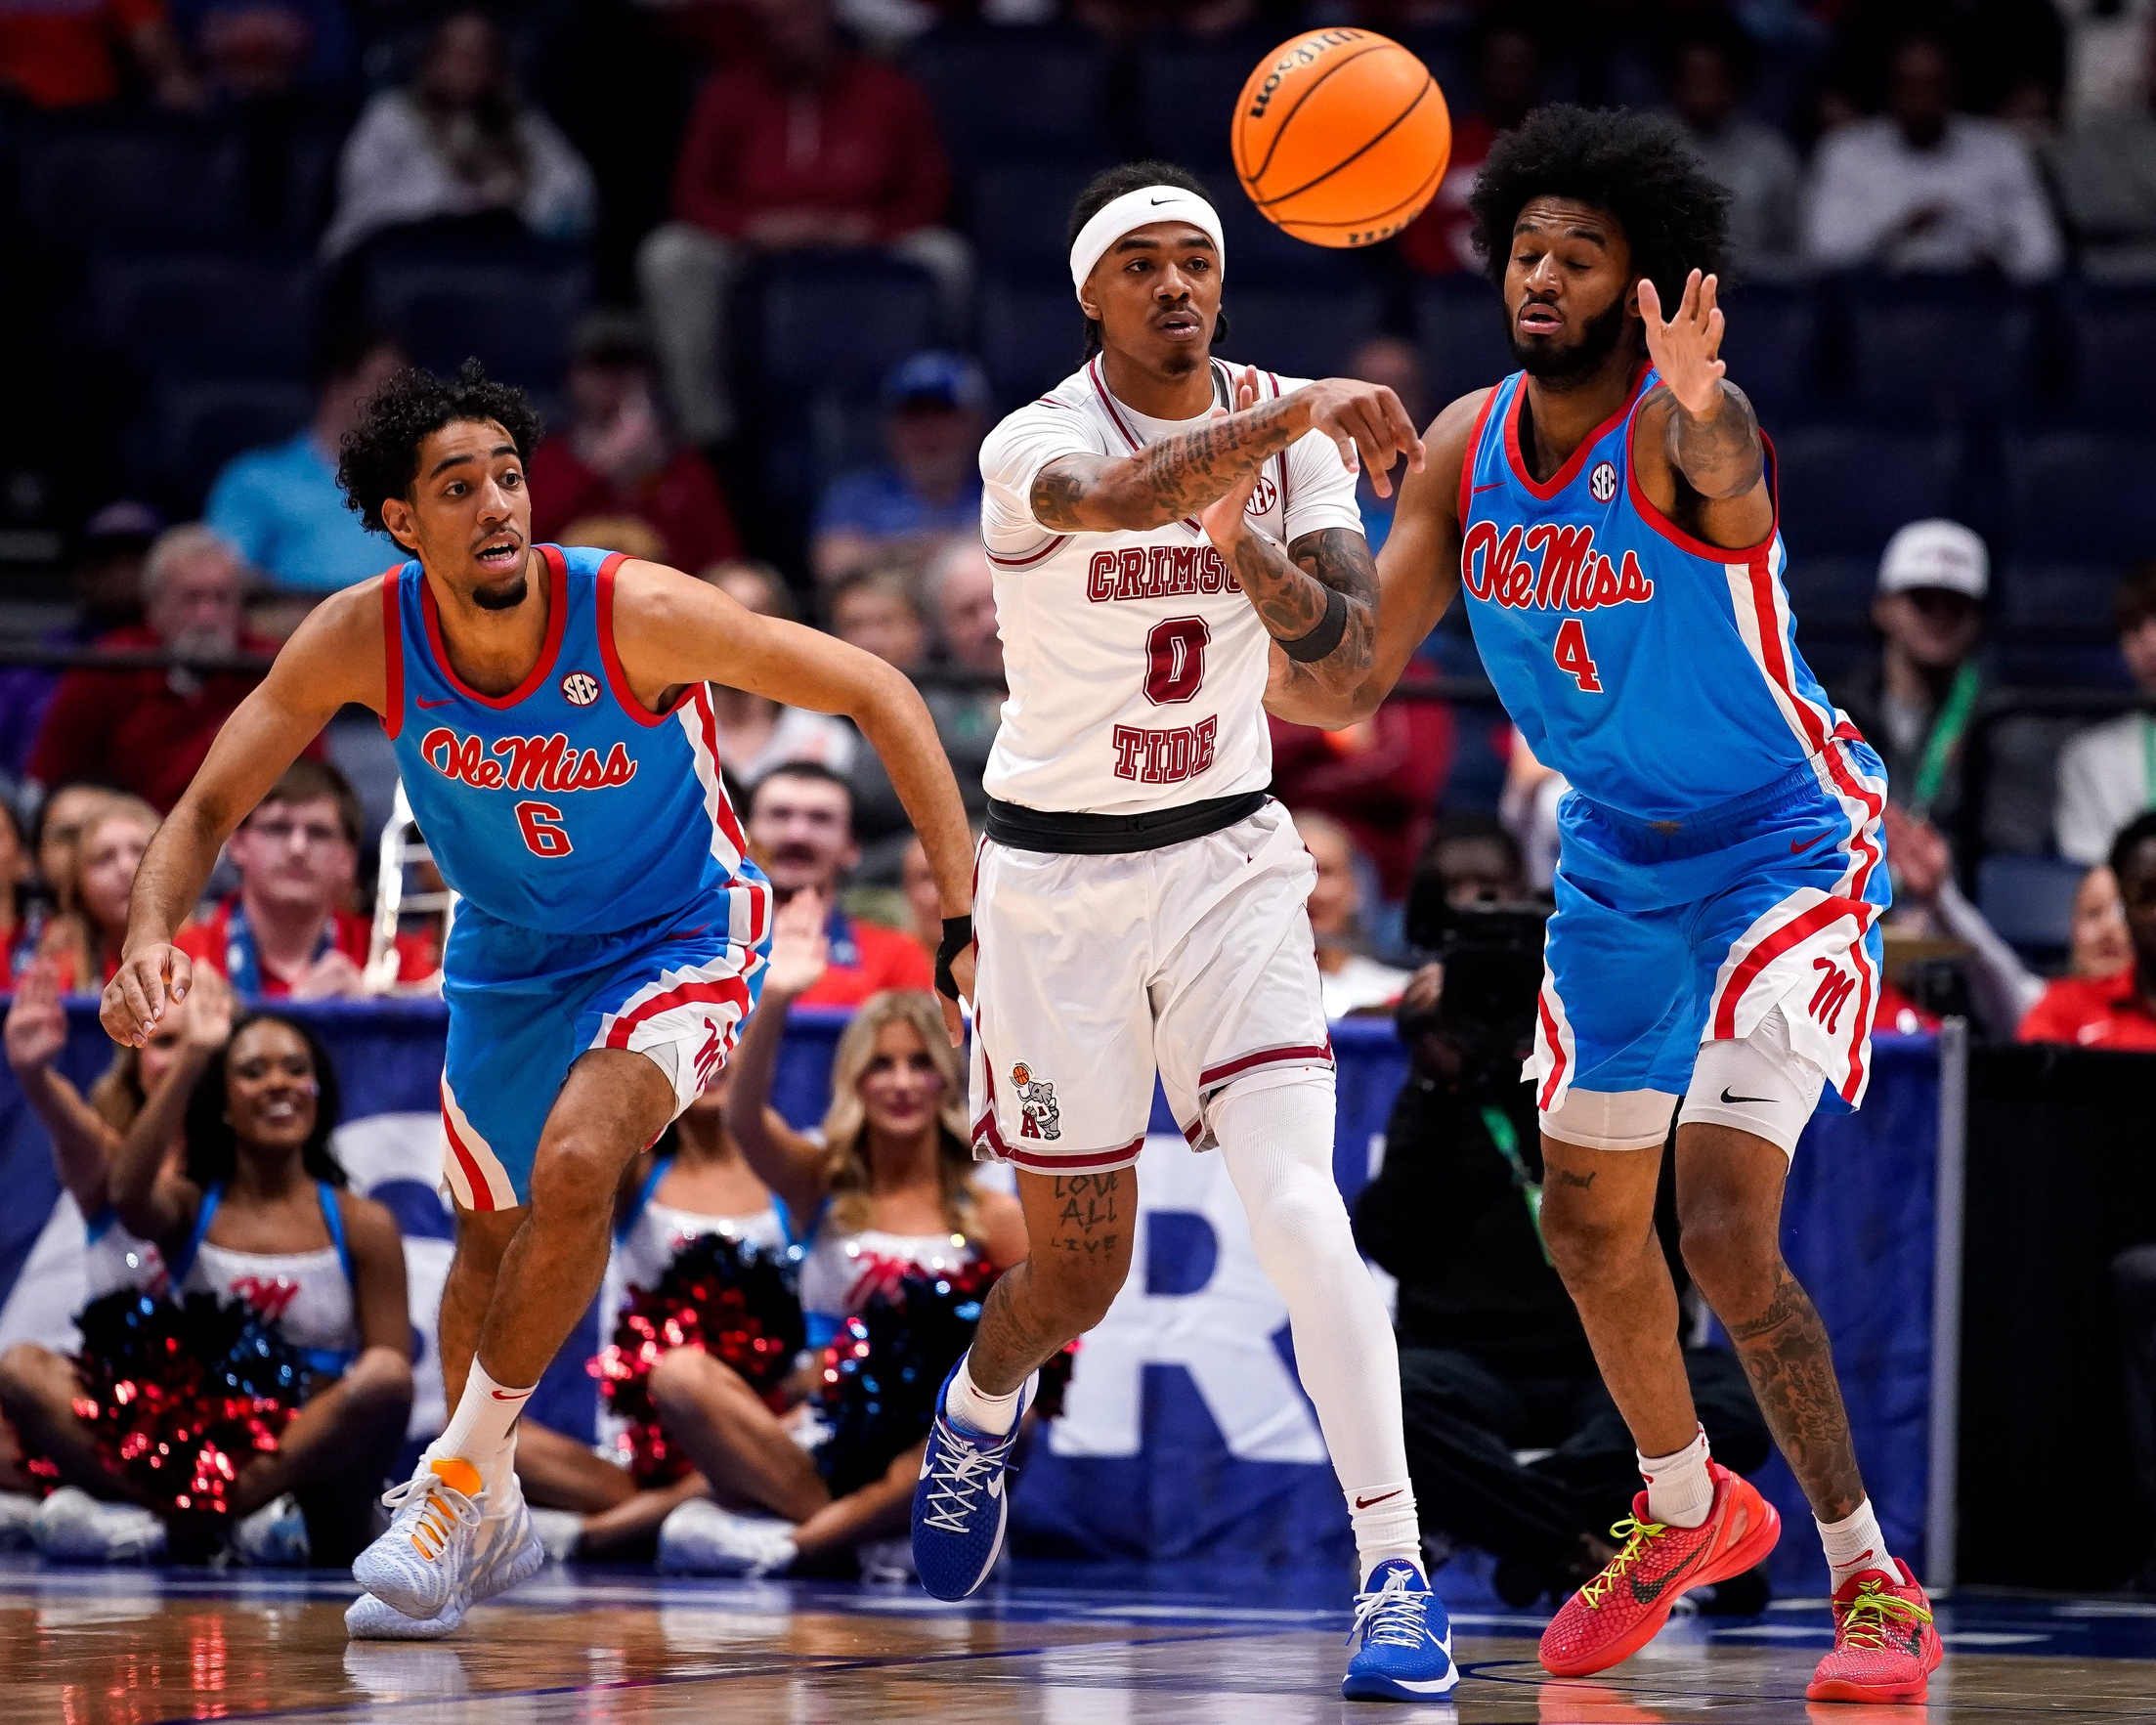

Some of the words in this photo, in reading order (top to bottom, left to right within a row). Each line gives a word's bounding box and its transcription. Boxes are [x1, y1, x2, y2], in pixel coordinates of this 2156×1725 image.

[1592, 462, 1616, 500] SEC
[1461, 521, 1534, 610] Ole
[1525, 524, 1654, 611] Miss
[1143, 615, 1211, 707] 0
[1554, 619, 1604, 693] 4
[563, 673, 598, 705] SEC
[421, 727, 504, 790] Ole
[492, 733, 637, 792] Miss
[1112, 713, 1217, 784] TIDE
[514, 800, 574, 857] 6
[1021, 1109, 1041, 1139] A
[1059, 1197, 1117, 1228] ALL
[1052, 1234, 1118, 1254] LIVE
